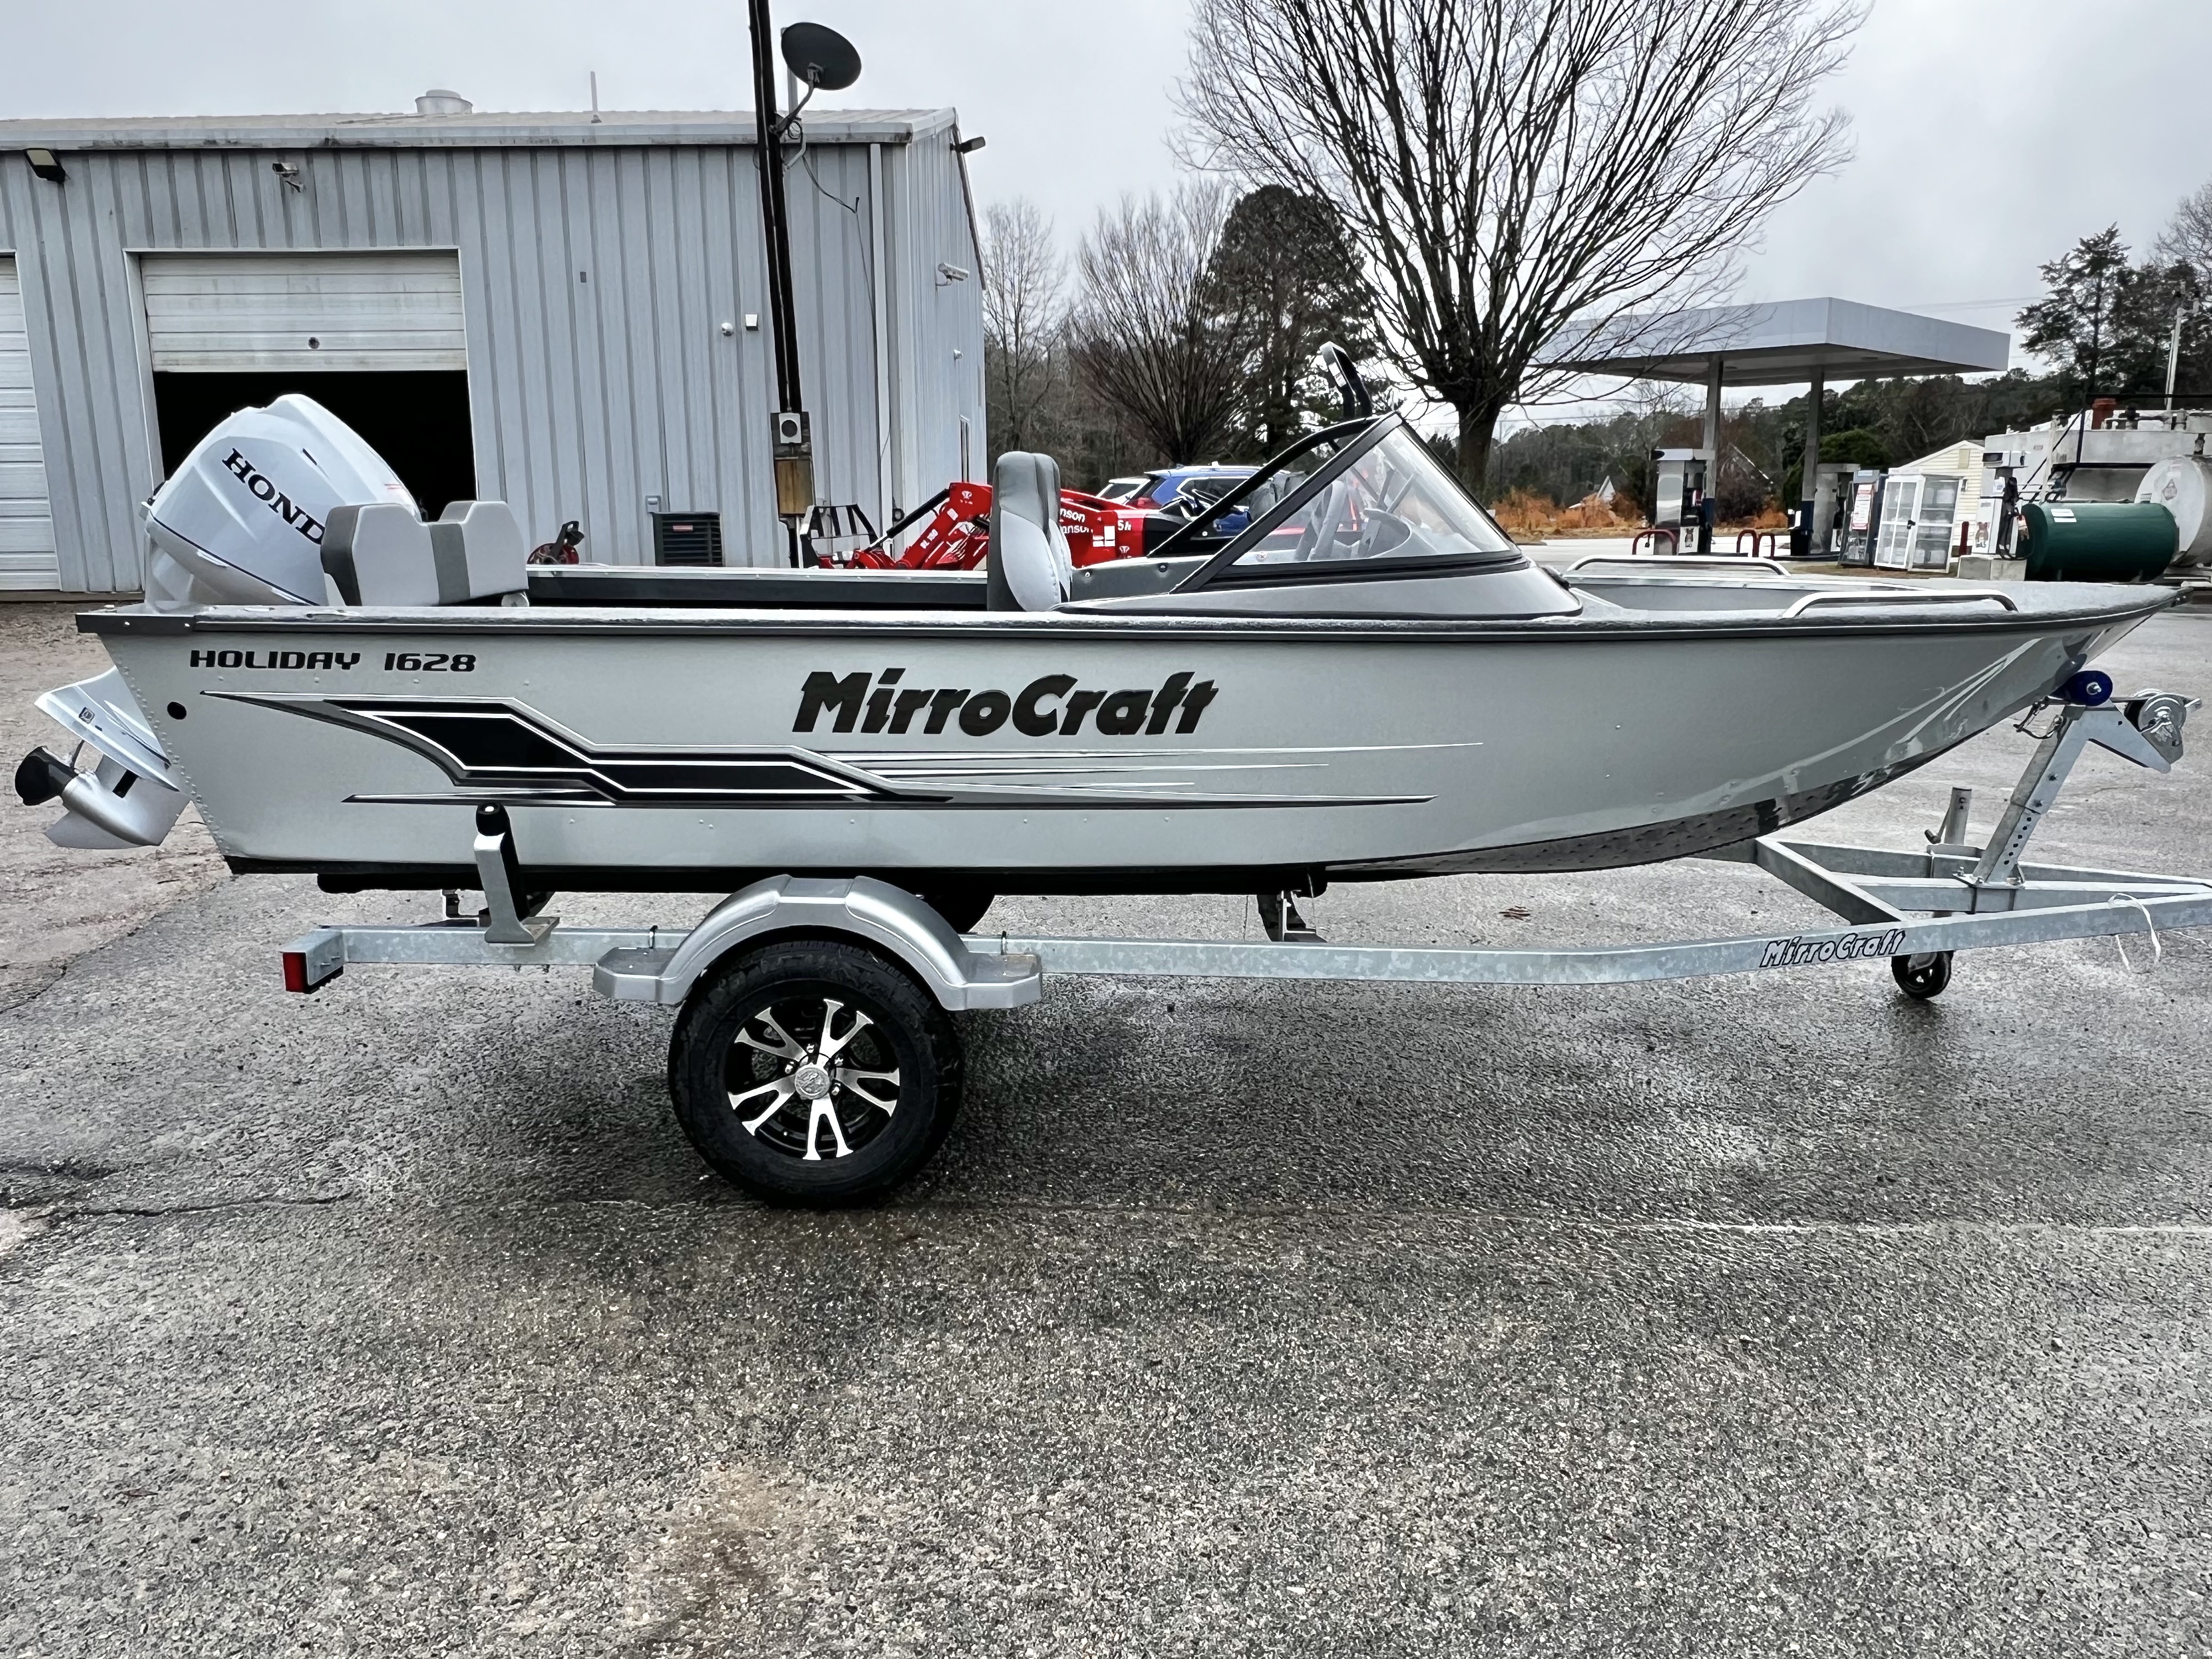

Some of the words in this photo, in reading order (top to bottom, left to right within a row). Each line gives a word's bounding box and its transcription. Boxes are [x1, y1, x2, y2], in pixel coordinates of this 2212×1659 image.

[222, 448, 326, 545] HOND
[1059, 507, 1086, 523] nson
[189, 650, 361, 670] HOLIDAY
[384, 653, 476, 672] 1628
[792, 668, 1219, 737] MirroCraft
[1759, 929, 1906, 968] MirroCraft
